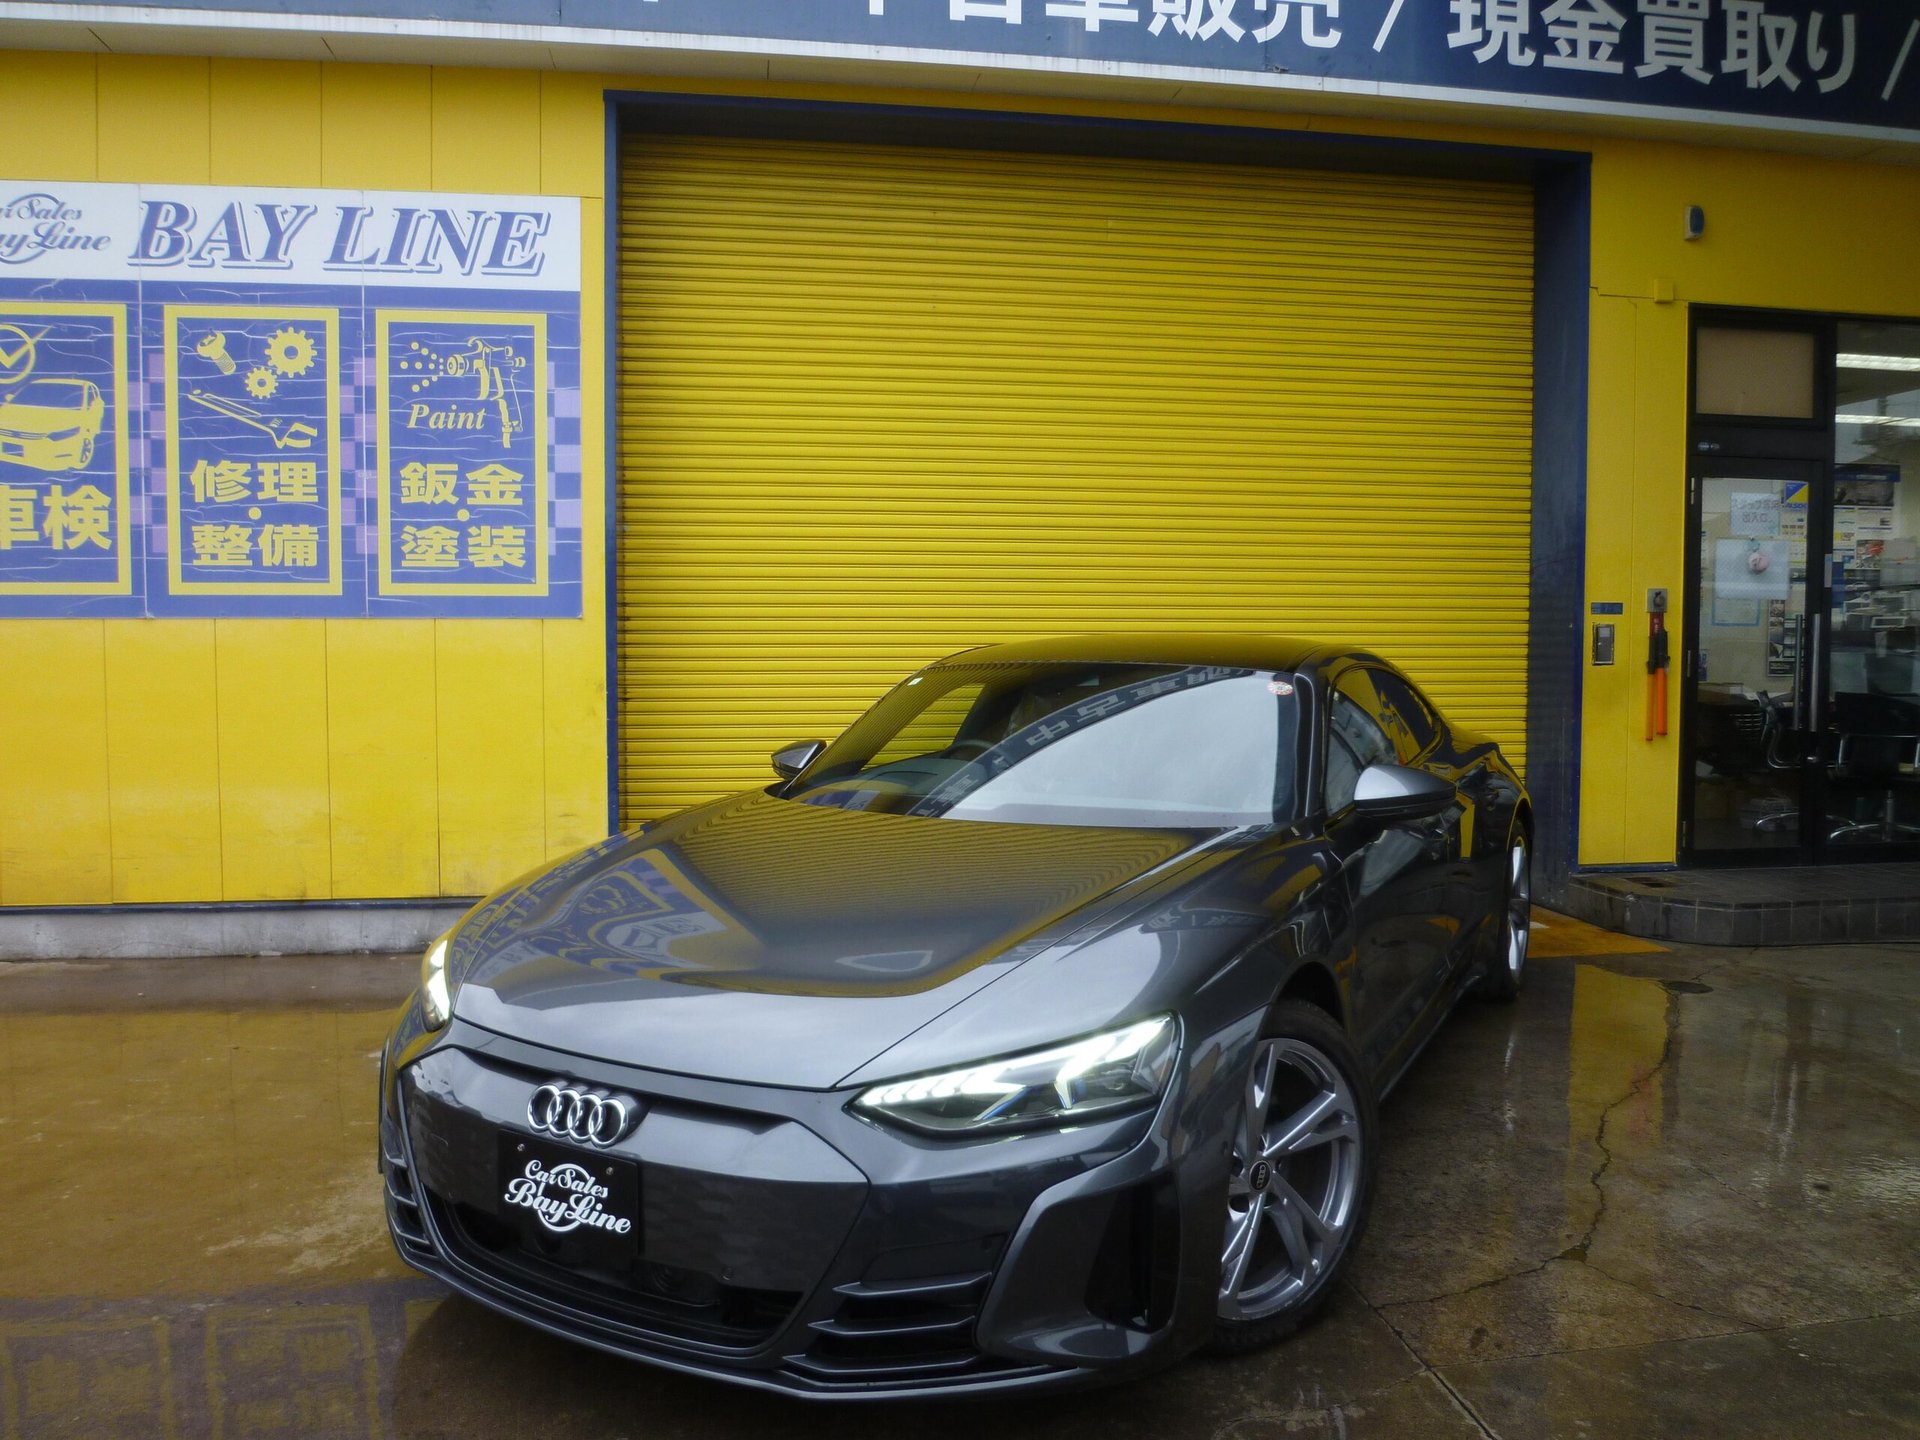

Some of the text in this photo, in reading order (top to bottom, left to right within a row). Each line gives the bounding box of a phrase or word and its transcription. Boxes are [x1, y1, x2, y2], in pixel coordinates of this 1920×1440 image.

[17, 198, 82, 220] Sales
[26, 221, 111, 251] Line
[127, 200, 552, 277] BAY LINE
[406, 403, 487, 430] Paint
[189, 459, 319, 503] 修理
[399, 463, 524, 506] 鈑金
[192, 524, 319, 567] 整備
[401, 525, 526, 568] 塗装
[524, 1159, 609, 1198] Car Sales
[504, 1177, 632, 1233] Bay Line
